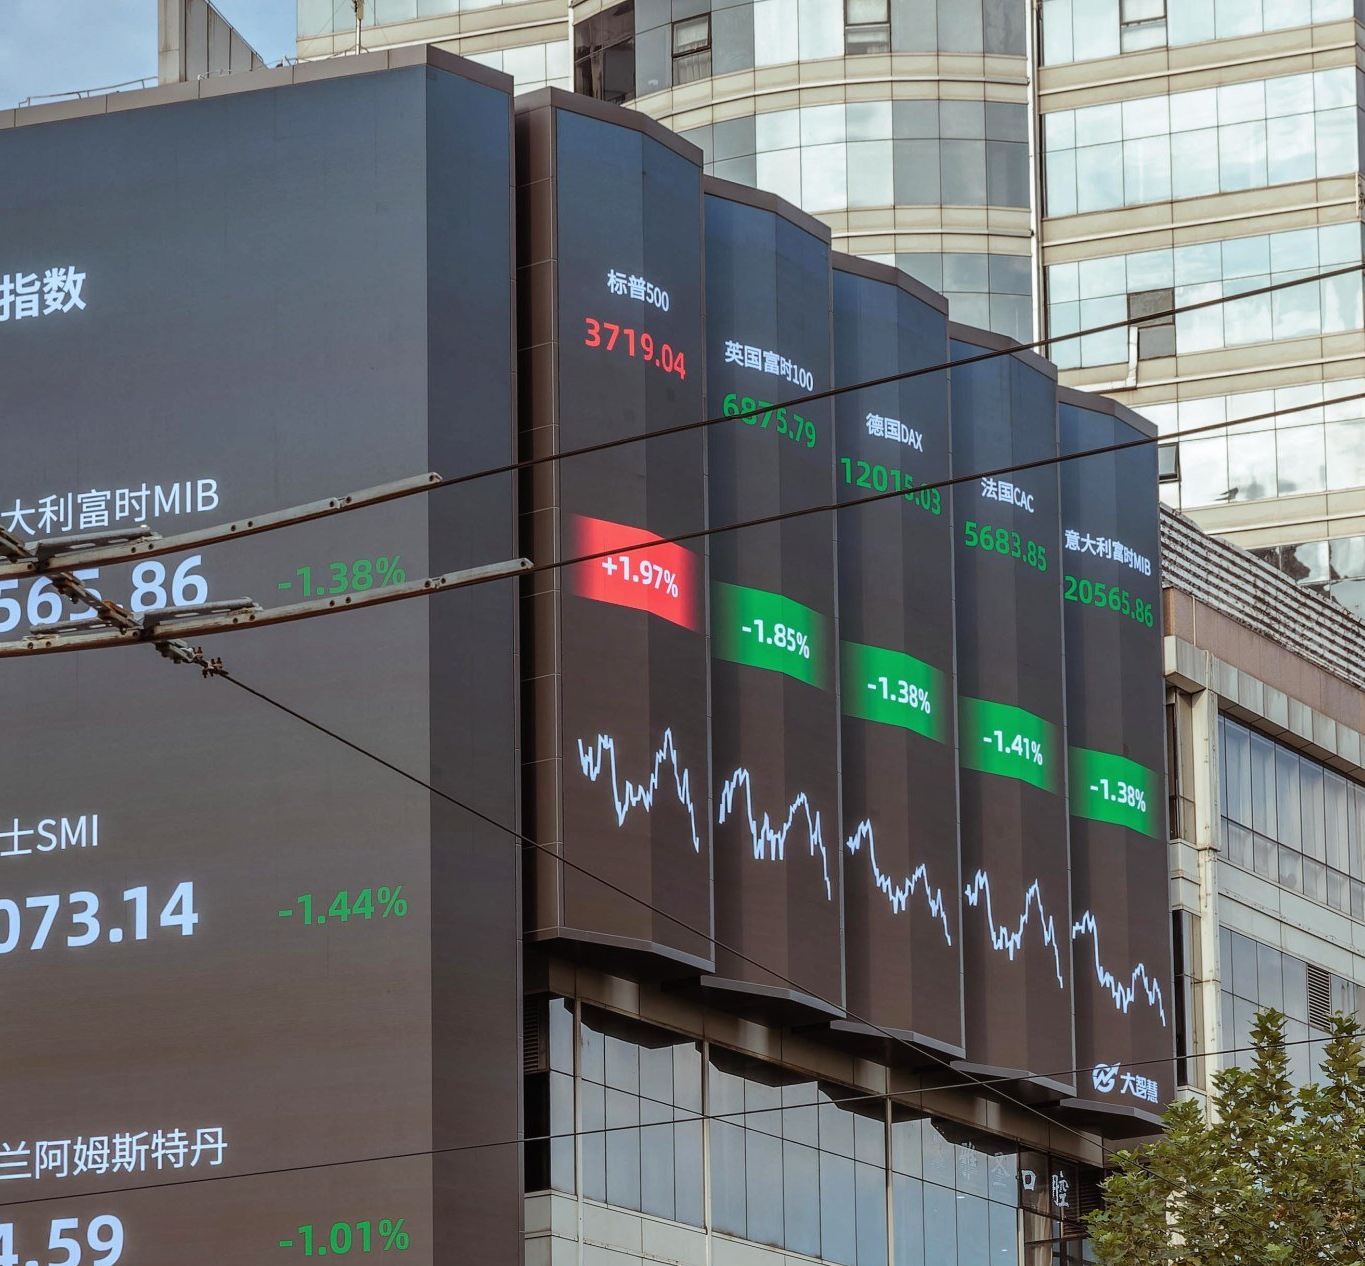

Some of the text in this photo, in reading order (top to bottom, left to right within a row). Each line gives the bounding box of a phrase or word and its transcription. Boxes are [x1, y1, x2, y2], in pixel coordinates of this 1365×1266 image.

[607, 269, 670, 311] 标普500
[585, 317, 686, 380] 3719.04
[725, 340, 814, 392] 英国富时100
[723, 393, 817, 448] 6875.79
[865, 412, 923, 453] 德国DAX
[840, 457, 941, 515] 12015.03
[980, 477, 1034, 513] 法国CAC
[964, 520, 1048, 572] 5683.85
[1064, 529, 1152, 576] 意大利富时MIB
[278, 556, 407, 597] -1.38%
[601, 555, 679, 598] +1.97%
[1064, 575, 1154, 627] 20565.86
[742, 618, 810, 660] -1.85%
[867, 675, 932, 715] -1.38%
[982, 729, 1044, 767] -1.41%
[1089, 775, 1147, 815] -1.38%
[278, 885, 408, 926] -1.44%
[1120, 1072, 1159, 1104] 大智慧
[278, 1218, 410, 1256] -1.01%
